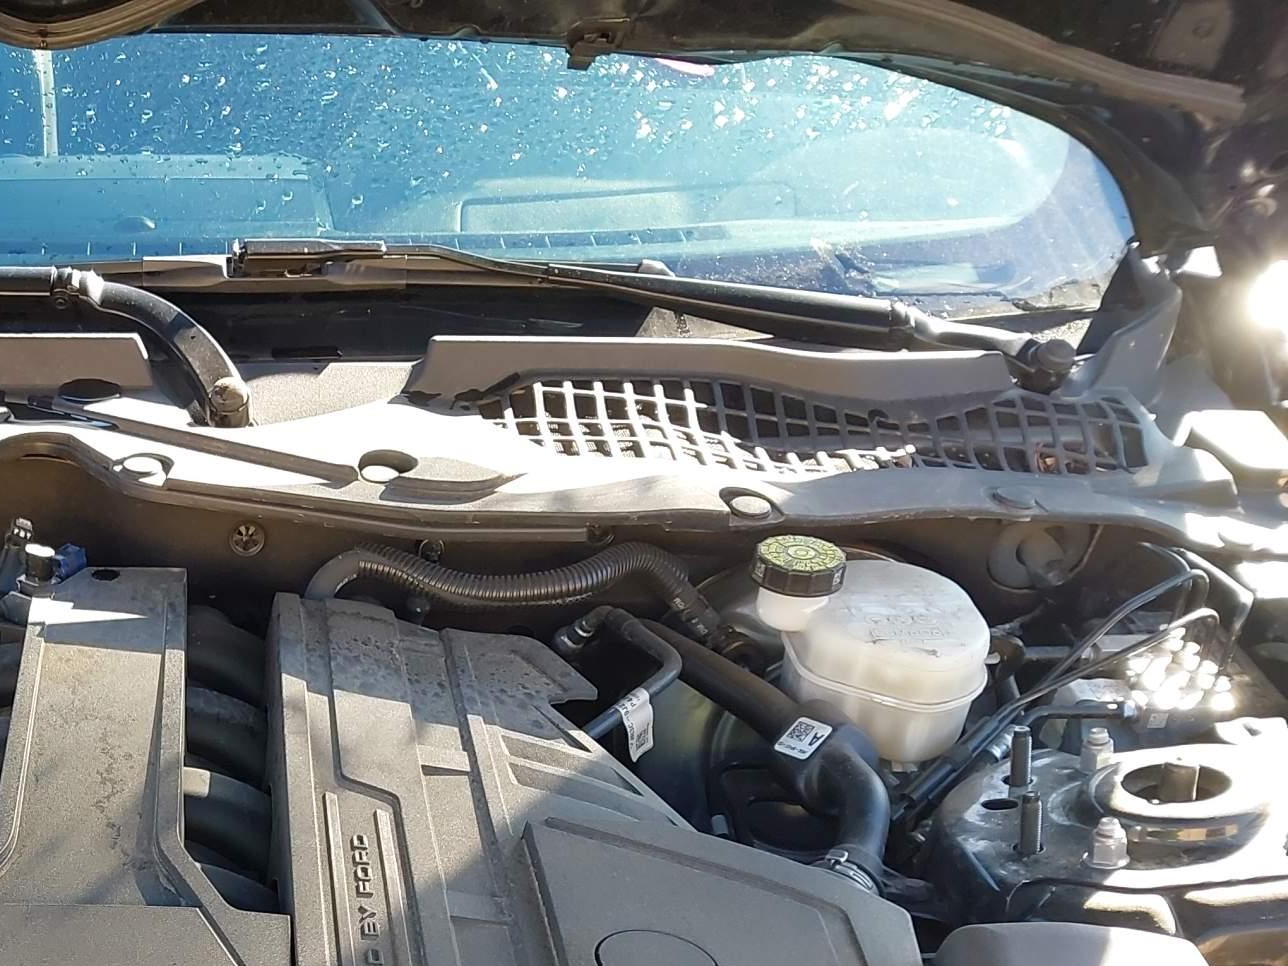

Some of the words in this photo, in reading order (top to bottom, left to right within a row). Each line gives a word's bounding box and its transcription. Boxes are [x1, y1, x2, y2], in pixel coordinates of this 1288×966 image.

[807, 731, 826, 747] A
[350, 834, 374, 899] FORD
[357, 905, 380, 941] BY
